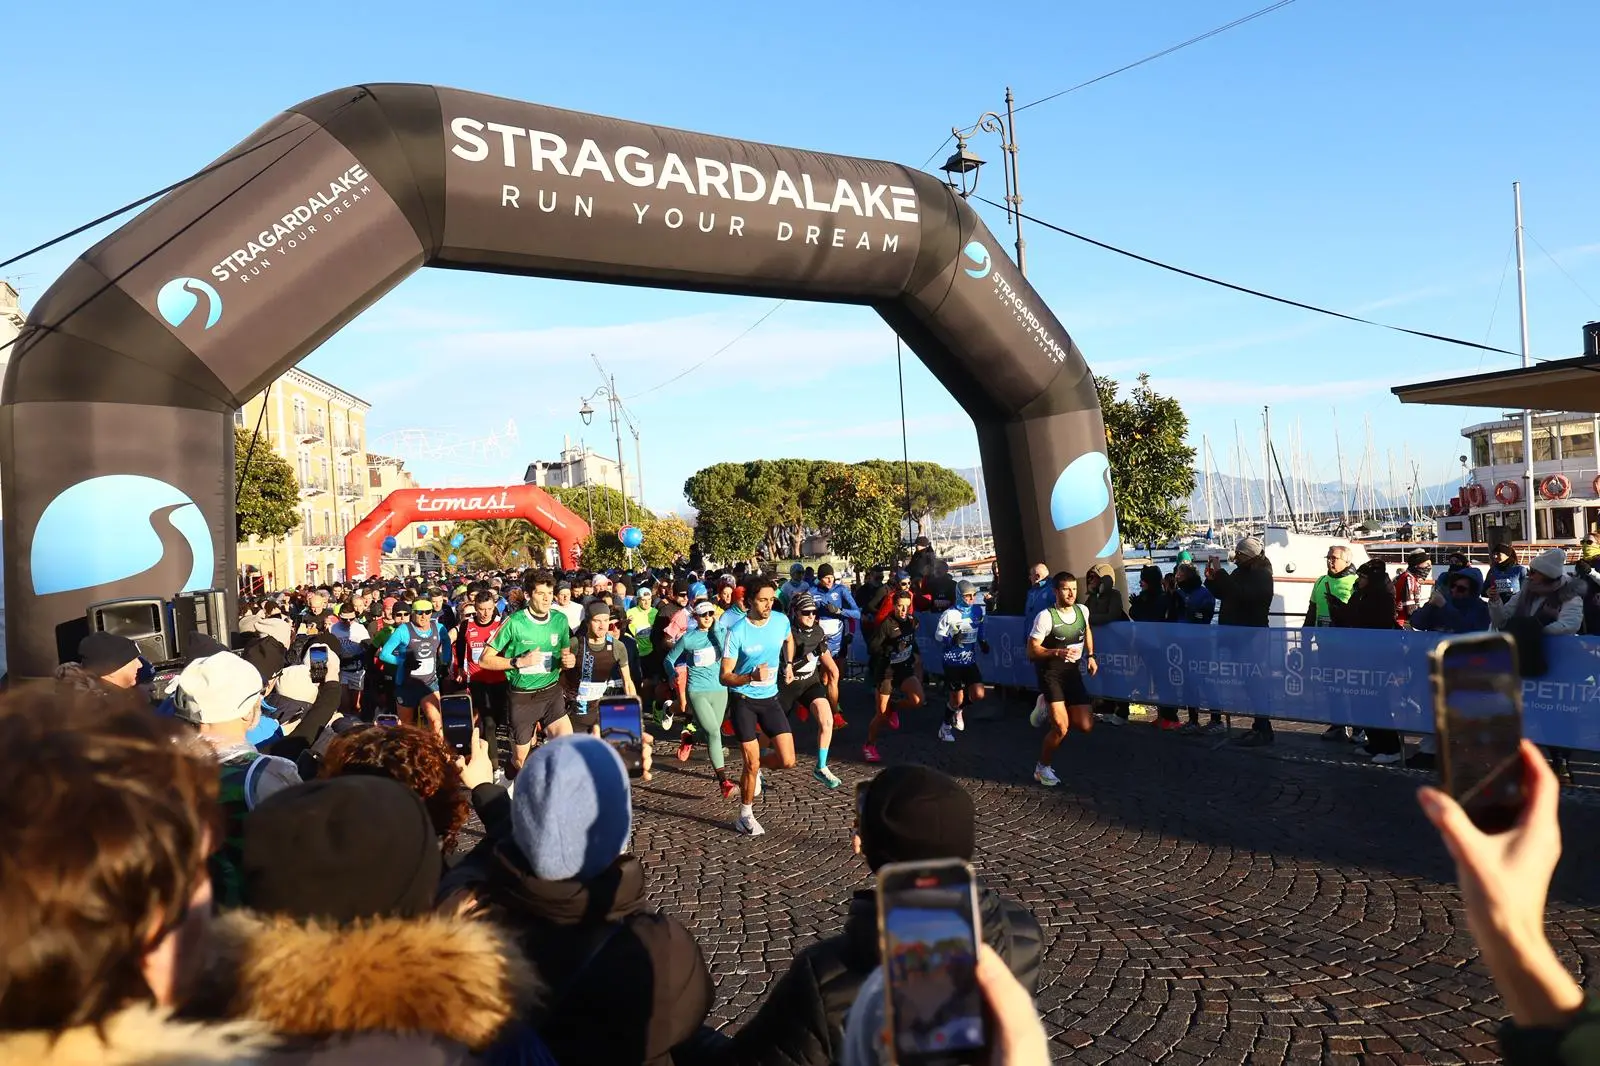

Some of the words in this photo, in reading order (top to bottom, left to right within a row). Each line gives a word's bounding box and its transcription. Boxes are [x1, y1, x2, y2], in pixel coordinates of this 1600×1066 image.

[450, 117, 919, 223] STRAGARDALAKE
[211, 164, 370, 283] STRAGARDALAKE
[240, 259, 271, 284] RUN
[277, 225, 318, 256] YOUR
[323, 185, 371, 223] DREAM
[502, 185, 592, 218] RUN
[633, 203, 745, 237] YOUR
[777, 222, 899, 253] DREAM
[992, 271, 1066, 362] STRAGARDALAKE
[993, 288, 1010, 307] RUN
[1012, 309, 1032, 334] YOUR
[1034, 336, 1058, 364] DREAM
[416, 491, 516, 512] tomasi
[1188, 660, 1263, 678] REPETITA
[1310, 666, 1400, 688] REPETITA
[1521, 680, 1600, 703] PETITA
[1531, 701, 1554, 713] loop
